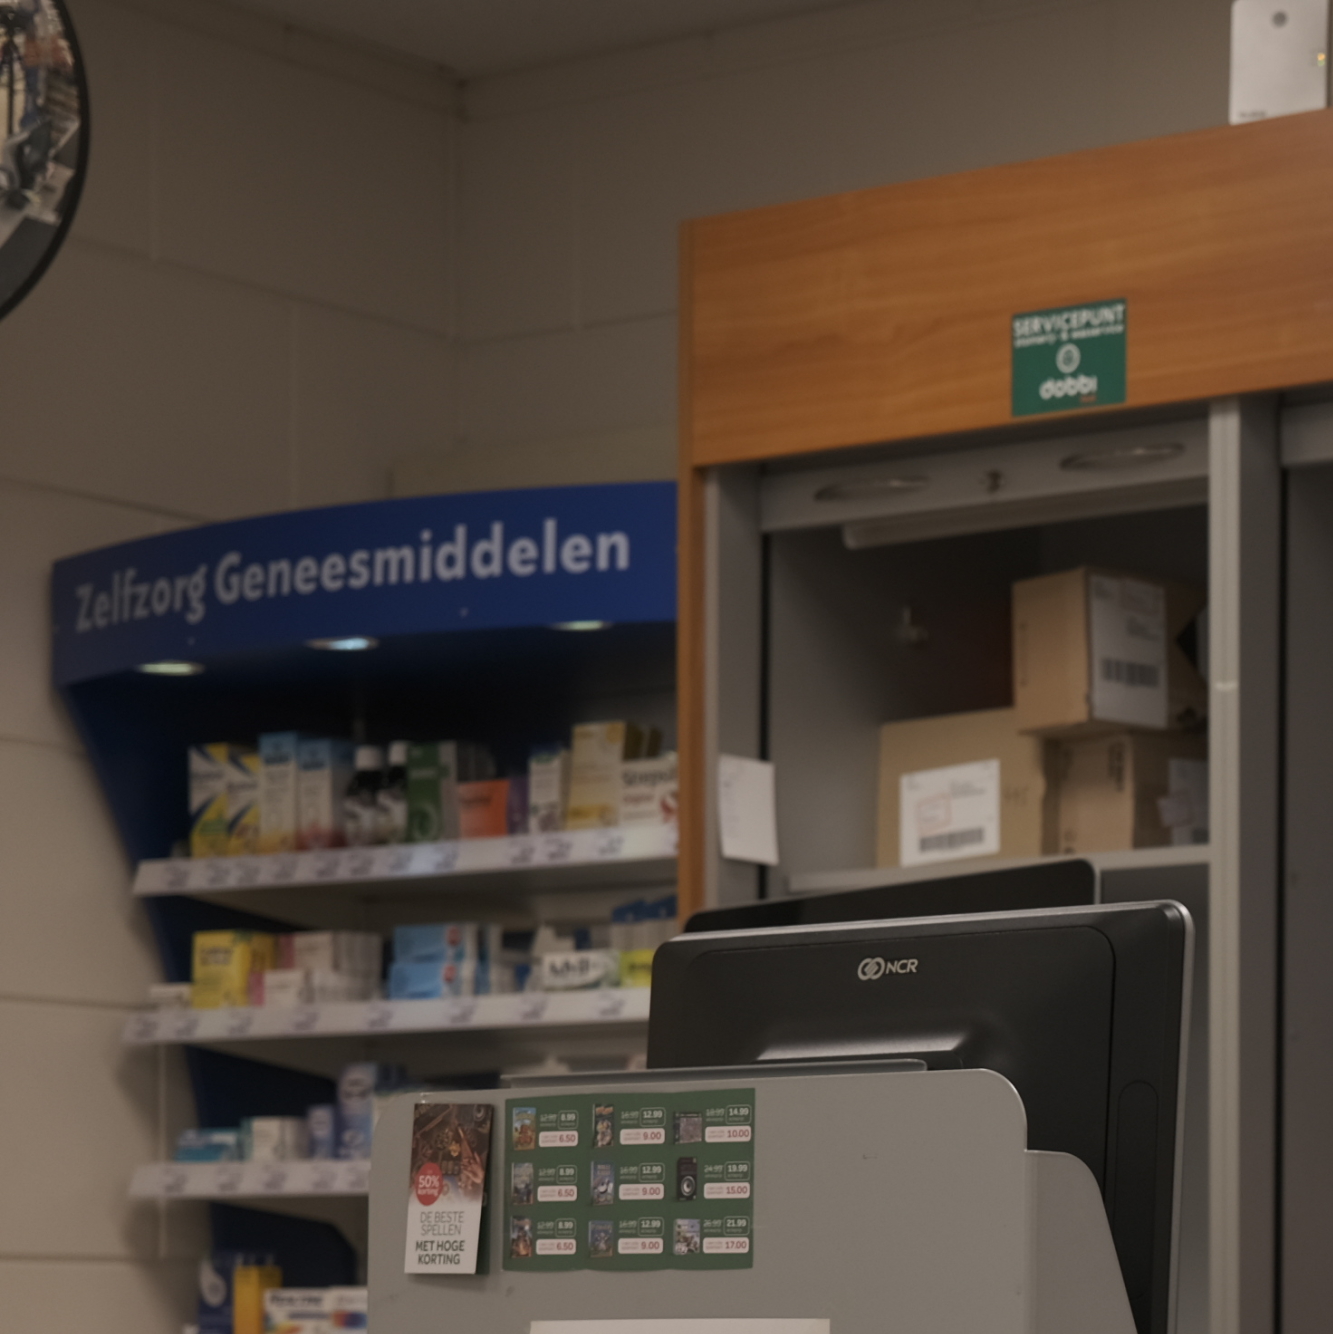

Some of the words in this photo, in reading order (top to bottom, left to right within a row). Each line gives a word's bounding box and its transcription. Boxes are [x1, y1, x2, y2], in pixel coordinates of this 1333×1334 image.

[1013, 303, 1124, 337] SERVICEPUNT
[1039, 374, 1097, 400] dobbi
[74, 563, 207, 633] Zelfzorg
[213, 517, 631, 604] Geneesmiddelen
[885, 957, 919, 975] NCR
[559, 1133, 576, 1143] 6.50
[642, 1131, 662, 1141] 9.00
[727, 1129, 750, 1138] 10.00
[418, 1174, 440, 1188] 50%
[557, 1188, 575, 1198] 6.50
[641, 1186, 661, 1196] 9.00
[726, 1185, 748, 1195] 15.00
[420, 1211, 433, 1224] DE
[434, 1211, 465, 1224] BESTE
[421, 1224, 462, 1237] SPELLEN
[416, 1239, 434, 1252] MET
[436, 1240, 465, 1252] HOGE
[556, 1241, 574, 1251] 6.50
[640, 1240, 660, 1250] 9.00
[725, 1240, 747, 1249] 17.00
[418, 1253, 460, 1265] KORTING
